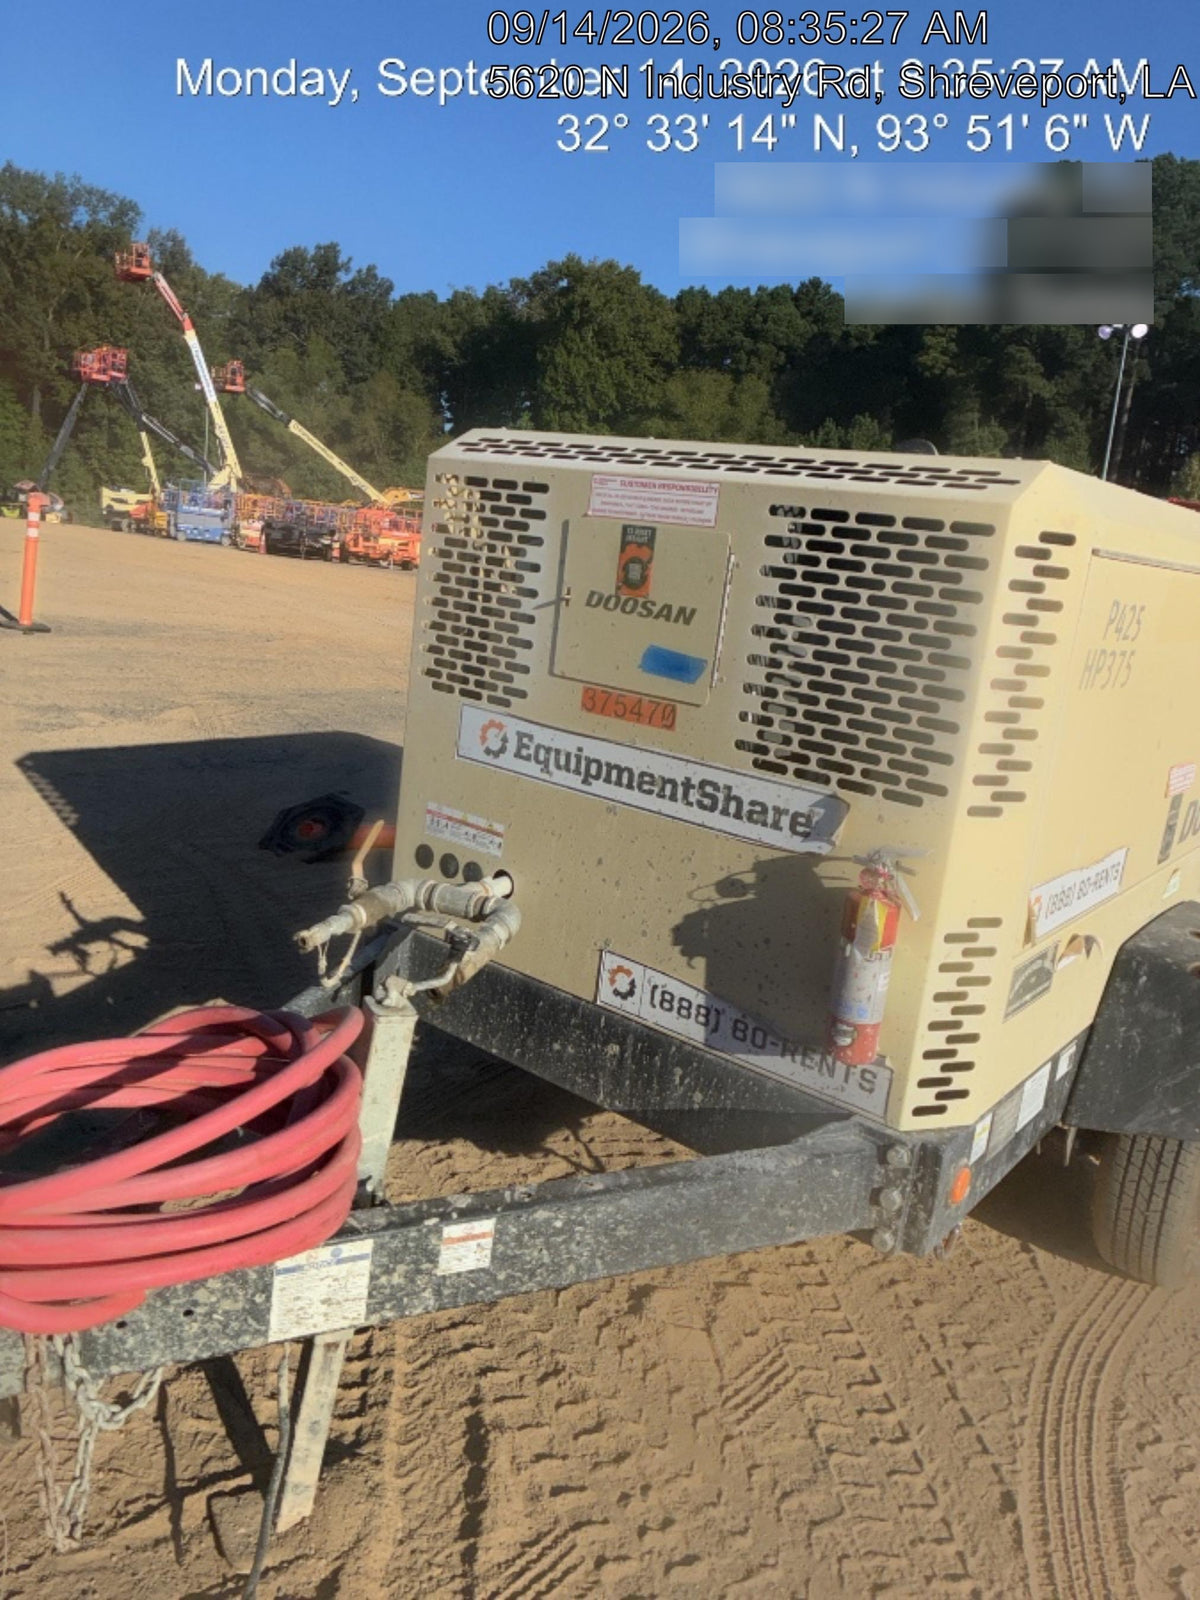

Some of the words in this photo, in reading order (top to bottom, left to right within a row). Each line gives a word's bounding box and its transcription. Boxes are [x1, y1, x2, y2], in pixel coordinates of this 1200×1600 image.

[585, 589, 698, 626] DOOSAN
[1079, 648, 1136, 690] HP375
[583, 687, 677, 730] 375470
[513, 730, 815, 838] EquipmentShare
[650, 984, 720, 1034] (888)
